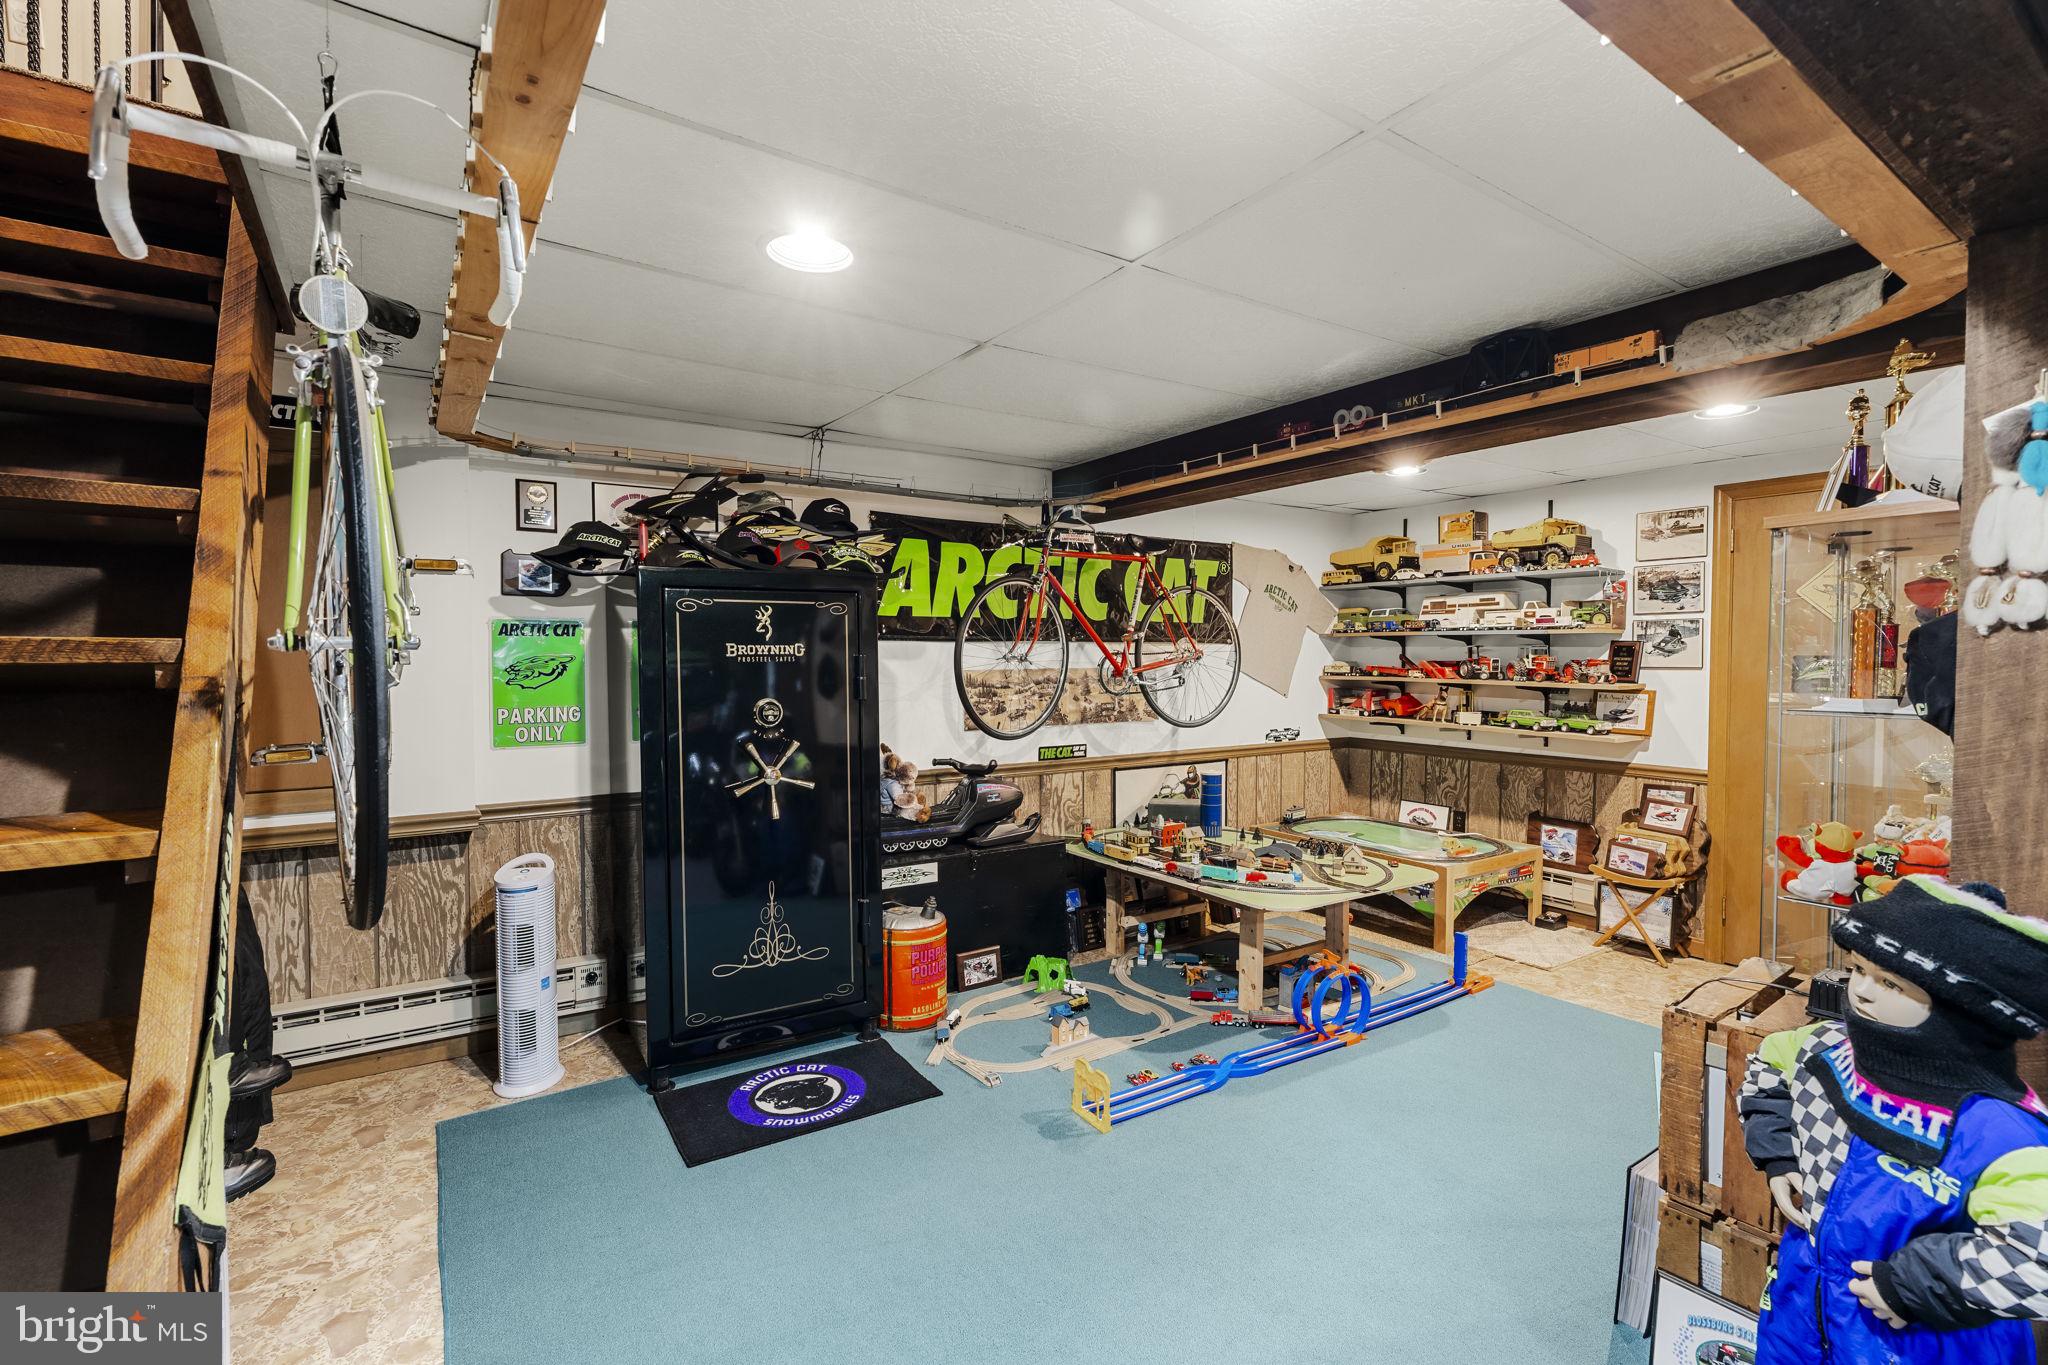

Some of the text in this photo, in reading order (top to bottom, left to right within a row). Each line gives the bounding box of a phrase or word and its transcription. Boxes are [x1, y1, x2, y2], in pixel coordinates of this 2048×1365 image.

[576, 532, 622, 547] ARCTIC CAT
[878, 538, 1112, 621] ARCTIC
[1263, 584, 1288, 600] ARCTIC
[1287, 596, 1298, 612] CAT
[498, 622, 580, 637] ARCTIC CAT
[725, 642, 806, 657] BROWNING
[497, 705, 581, 725] PARKING
[515, 725, 565, 743] ONLY
[1040, 748, 1056, 759] THE
[739, 1064, 829, 1091] ARCTIC CAT
[763, 1094, 860, 1127] SNOWMOBILES
[1871, 1093, 1954, 1142] CAT
[1876, 1154, 1961, 1205] CAT
[1687, 1314, 1735, 1336] BLOSSBURG
